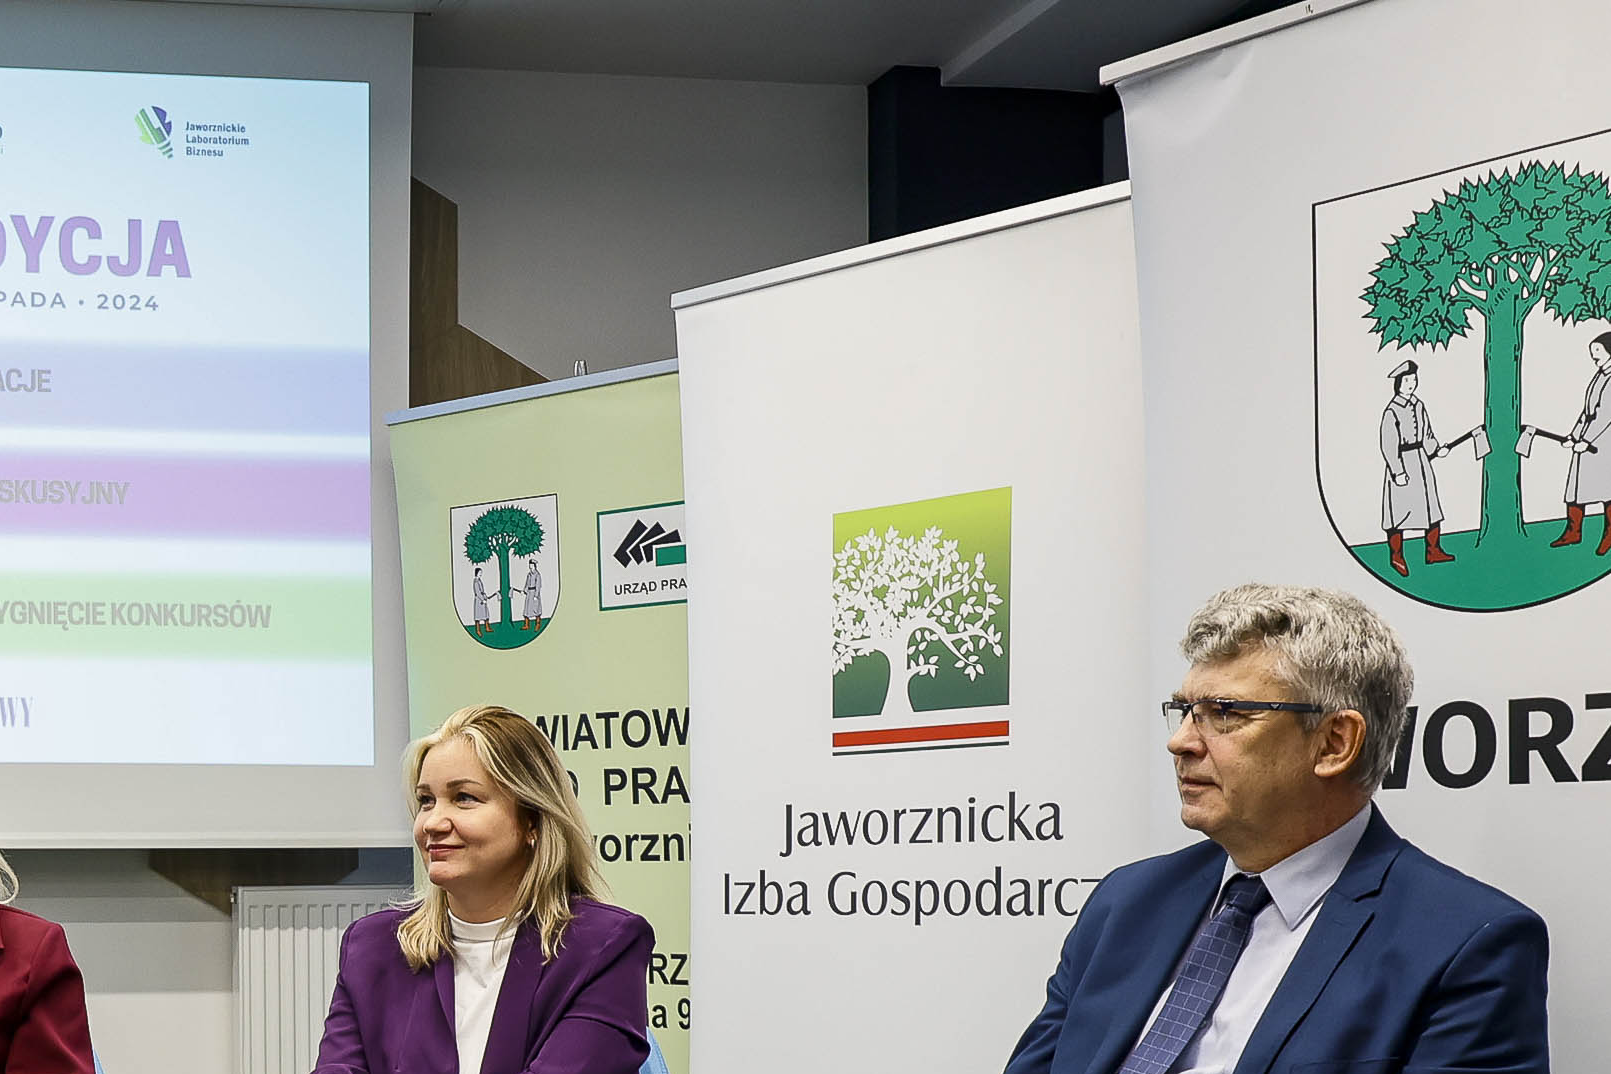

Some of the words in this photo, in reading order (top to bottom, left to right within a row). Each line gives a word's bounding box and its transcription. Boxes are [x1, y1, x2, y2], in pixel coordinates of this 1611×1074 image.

[185, 121, 246, 133] Jaworznickie
[185, 134, 250, 146] Laboratorium
[185, 146, 224, 158] Biznesu
[96, 293, 159, 311] 2024
[613, 580, 658, 596] URZĄD
[660, 578, 688, 591] PRA
[110, 600, 272, 629] KONKURSÓW
[603, 765, 691, 806] PRA
[779, 790, 1064, 858] Jaworznicka
[722, 869, 812, 916] Izba
[827, 865, 1102, 926] Gospodarc
